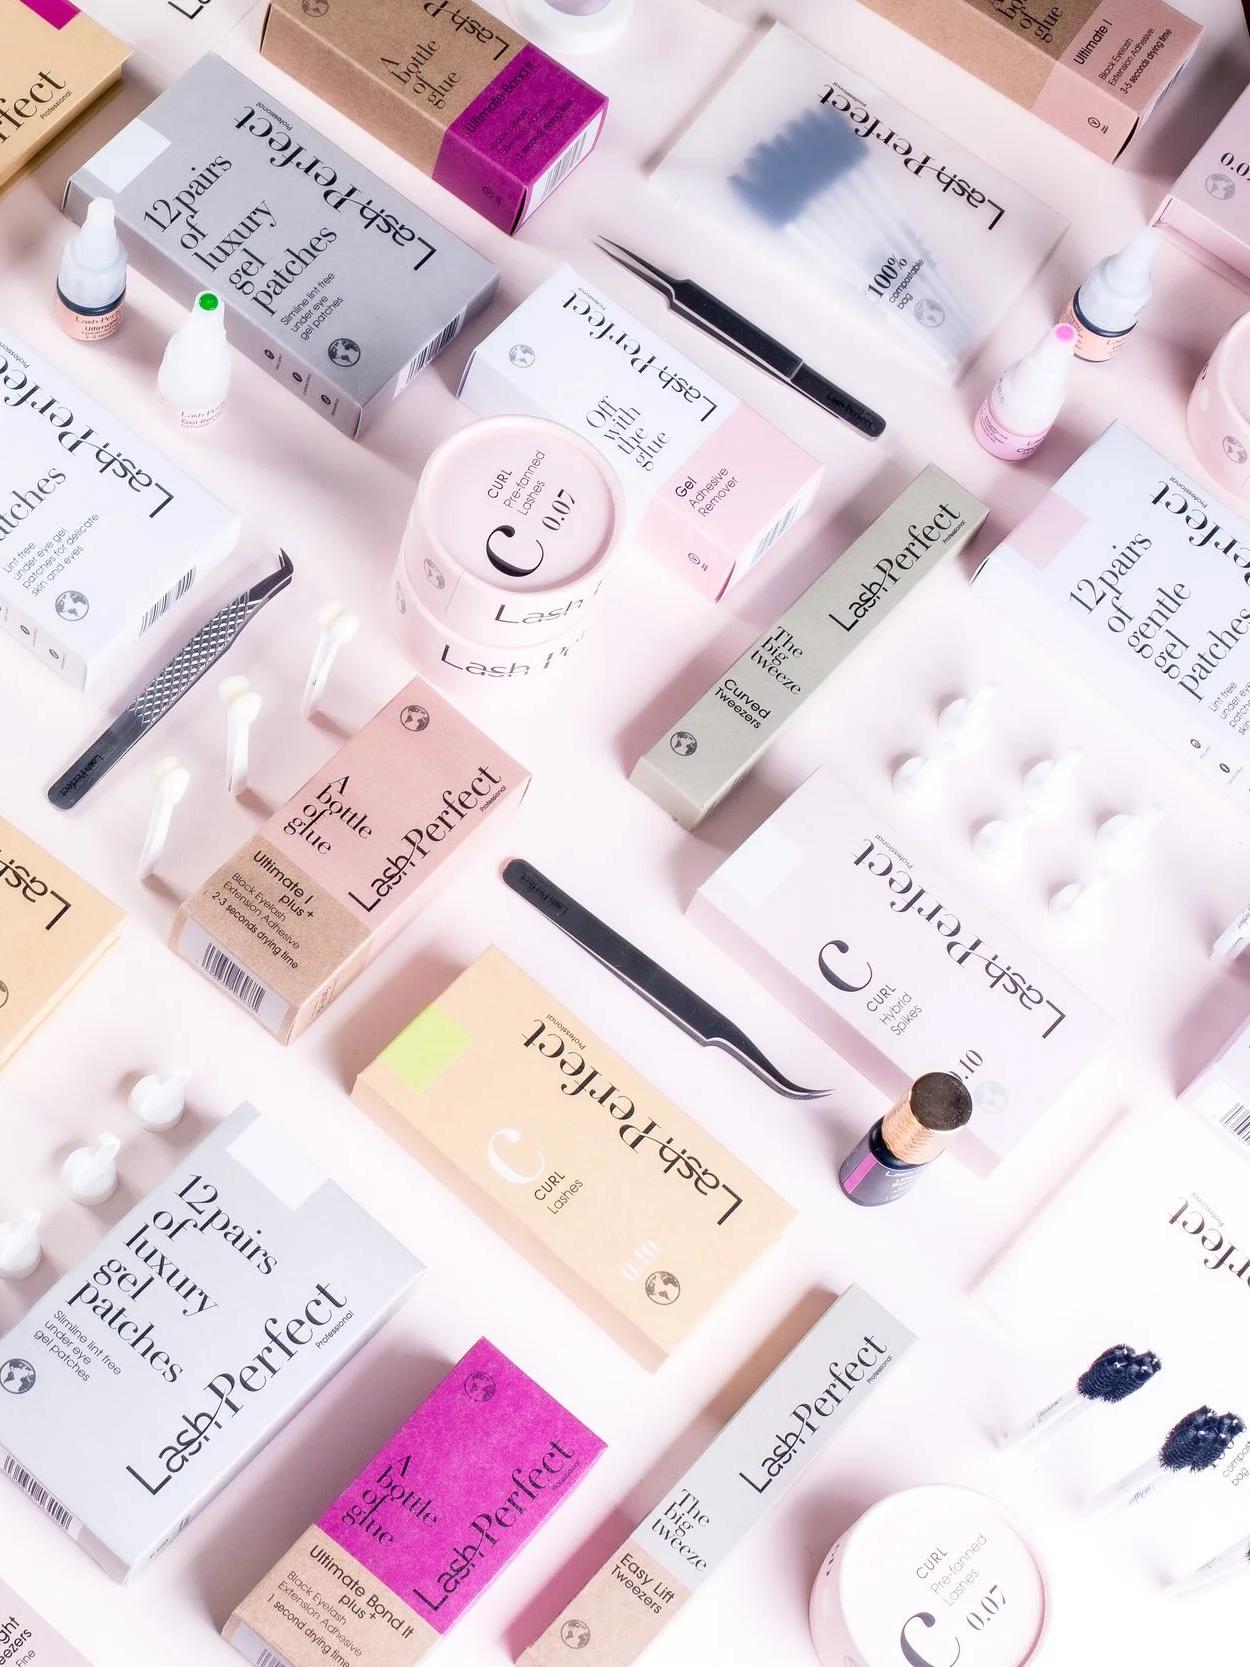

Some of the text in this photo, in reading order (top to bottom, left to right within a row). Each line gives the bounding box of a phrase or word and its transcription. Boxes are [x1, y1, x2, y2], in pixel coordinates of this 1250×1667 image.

[1035, 6, 1064, 43] glue
[379, 56, 400, 73] A
[1098, 38, 1134, 81] Black Eyelash
[1108, 27, 1155, 87] Extension Adhesive
[428, 70, 462, 110] glue
[179, 215, 209, 250] of
[192, 199, 278, 273] luxury
[228, 247, 268, 295] gel
[250, 226, 338, 317] patches
[291, 295, 330, 333] under eye
[300, 296, 344, 341] gel patches
[895, 292, 914, 310] bag
[585, 395, 612, 429] Off
[617, 426, 649, 455] the
[487, 468, 513, 499] CURL
[503, 450, 546, 508] Pre-fanned
[518, 480, 545, 516] Lashes
[675, 476, 698, 499] Gel
[688, 466, 729, 509] Adhesive
[698, 476, 738, 518] Remover
[541, 489, 576, 531] 0.07
[22, 513, 100, 590] patches for delicate
[1107, 596, 1135, 633] of
[1127, 581, 1192, 659] gentle
[761, 637, 790, 666] big
[776, 626, 803, 658] The
[1153, 629, 1190, 679] gel
[749, 651, 802, 695] tweeze
[714, 687, 761, 729] Tweezers
[723, 679, 771, 719] Curved
[328, 775, 351, 796] A
[231, 872, 287, 922] Black Eyelash
[866, 984, 897, 1013] CURL
[879, 991, 914, 1025] Hybrid
[890, 1004, 923, 1036] Spikes
[533, 1170, 566, 1201] CURL
[546, 1178, 584, 1216] Lashes
[152, 1209, 199, 1243] of
[122, 1222, 220, 1318] luxury
[619, 1238, 661, 1281] 0.10
[92, 1257, 157, 1303] gel
[66, 1279, 185, 1385] patches
[389, 1454, 413, 1479] A
[662, 1501, 694, 1538] big
[680, 1488, 711, 1527] The
[620, 1552, 675, 1604] Easy Lift
[915, 1547, 949, 1579] CURL
[930, 1532, 988, 1595] Pre-fanned
[286, 1570, 348, 1626] Black Eyelash
[610, 1564, 662, 1614] Tweezers
[942, 1568, 980, 1607] Lashes
[966, 1584, 1007, 1632] 0.07
